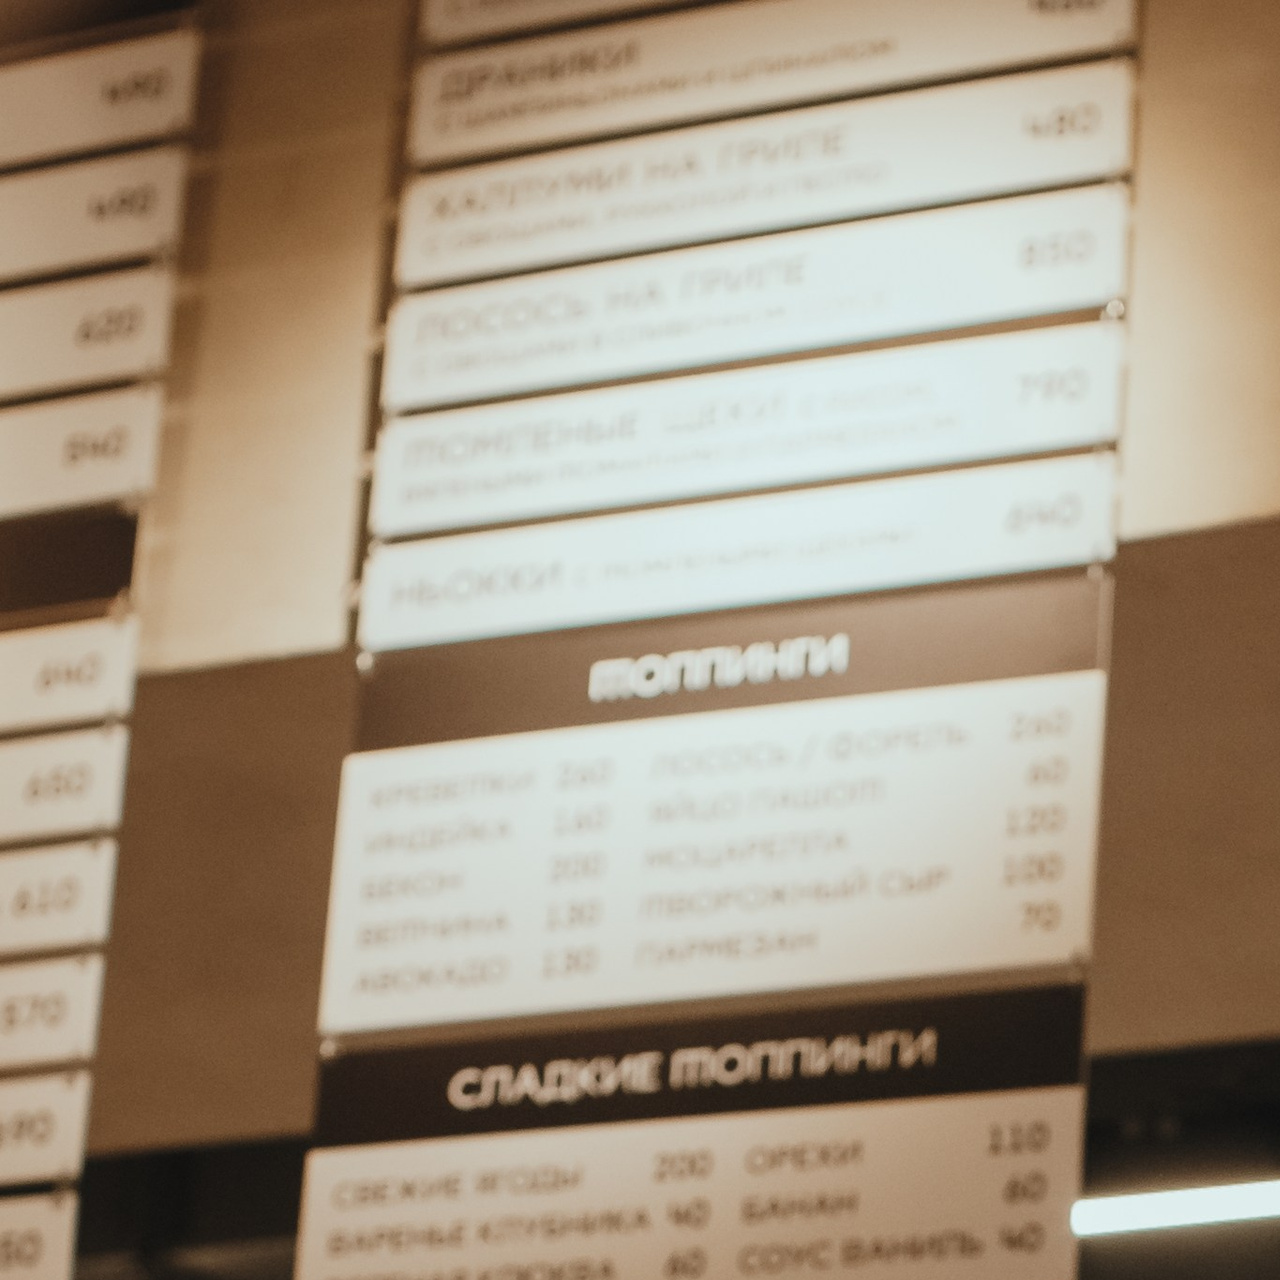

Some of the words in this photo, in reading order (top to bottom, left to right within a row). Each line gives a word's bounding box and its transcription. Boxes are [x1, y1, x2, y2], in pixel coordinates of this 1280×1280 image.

[587, 634, 850, 702] ТОППИНГИ
[651, 738, 790, 781] ЛОСОСЬ
[827, 722, 967, 766] ФОРЕЛЬ
[645, 827, 850, 876] МОЦАРЕЛЛА
[640, 868, 870, 920] ТВОРОЖНЫЙ
[879, 862, 951, 898] СЫР
[352, 954, 509, 995] АВОКАДО
[635, 931, 818, 967] ПАРМЕЗАН
[447, 1048, 665, 1110] СЛАДКИЕ
[669, 1027, 937, 1093] ТОППИНГИ
[0, 1108, 55, 1147] 90
[743, 1139, 864, 1177] ОРЕХИ
[986, 1120, 1050, 1157] 110
[332, 1172, 461, 1209] СВЕЖИЕ
[474, 1164, 584, 1200] ЯГОДЫ
[653, 1150, 713, 1183] 200
[741, 1190, 859, 1226] БАНАН
[326, 1219, 465, 1258] ВАРЕНЬЕ
[476, 1206, 651, 1249] КЛУБНИКА
[666, 1198, 710, 1230] 40
[736, 1239, 835, 1278] СОУС
[841, 1230, 985, 1270] ВАНИЛЬ
[997, 1221, 1044, 1254] 40
